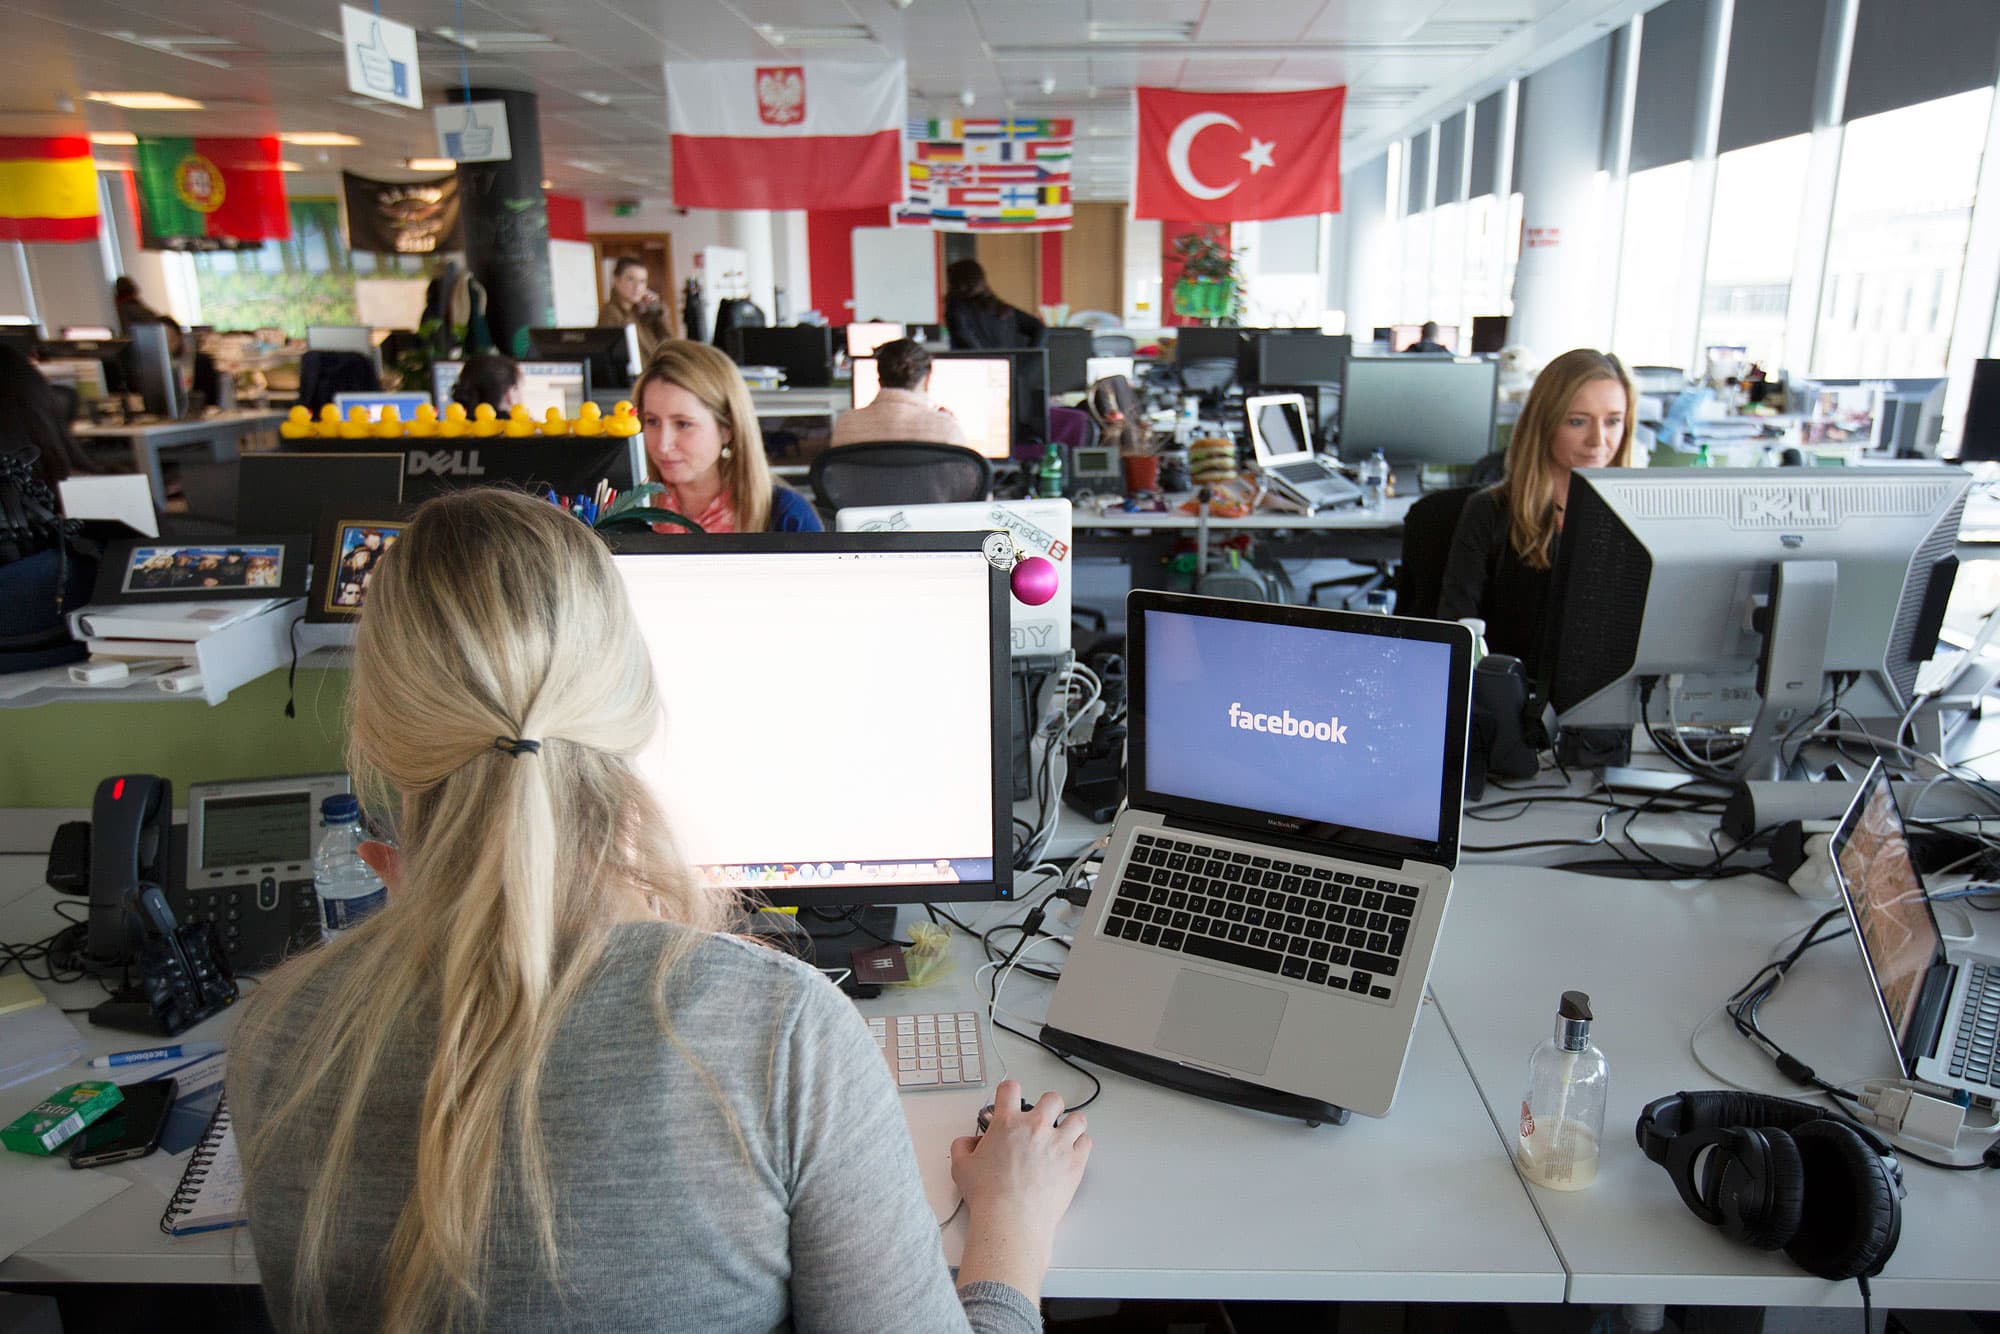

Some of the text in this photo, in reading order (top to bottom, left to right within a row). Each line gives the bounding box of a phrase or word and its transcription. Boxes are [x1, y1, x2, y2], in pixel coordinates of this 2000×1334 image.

[407, 449, 485, 476] DELL
[1740, 492, 1829, 521] DELL
[1229, 702, 1348, 745] facebook
